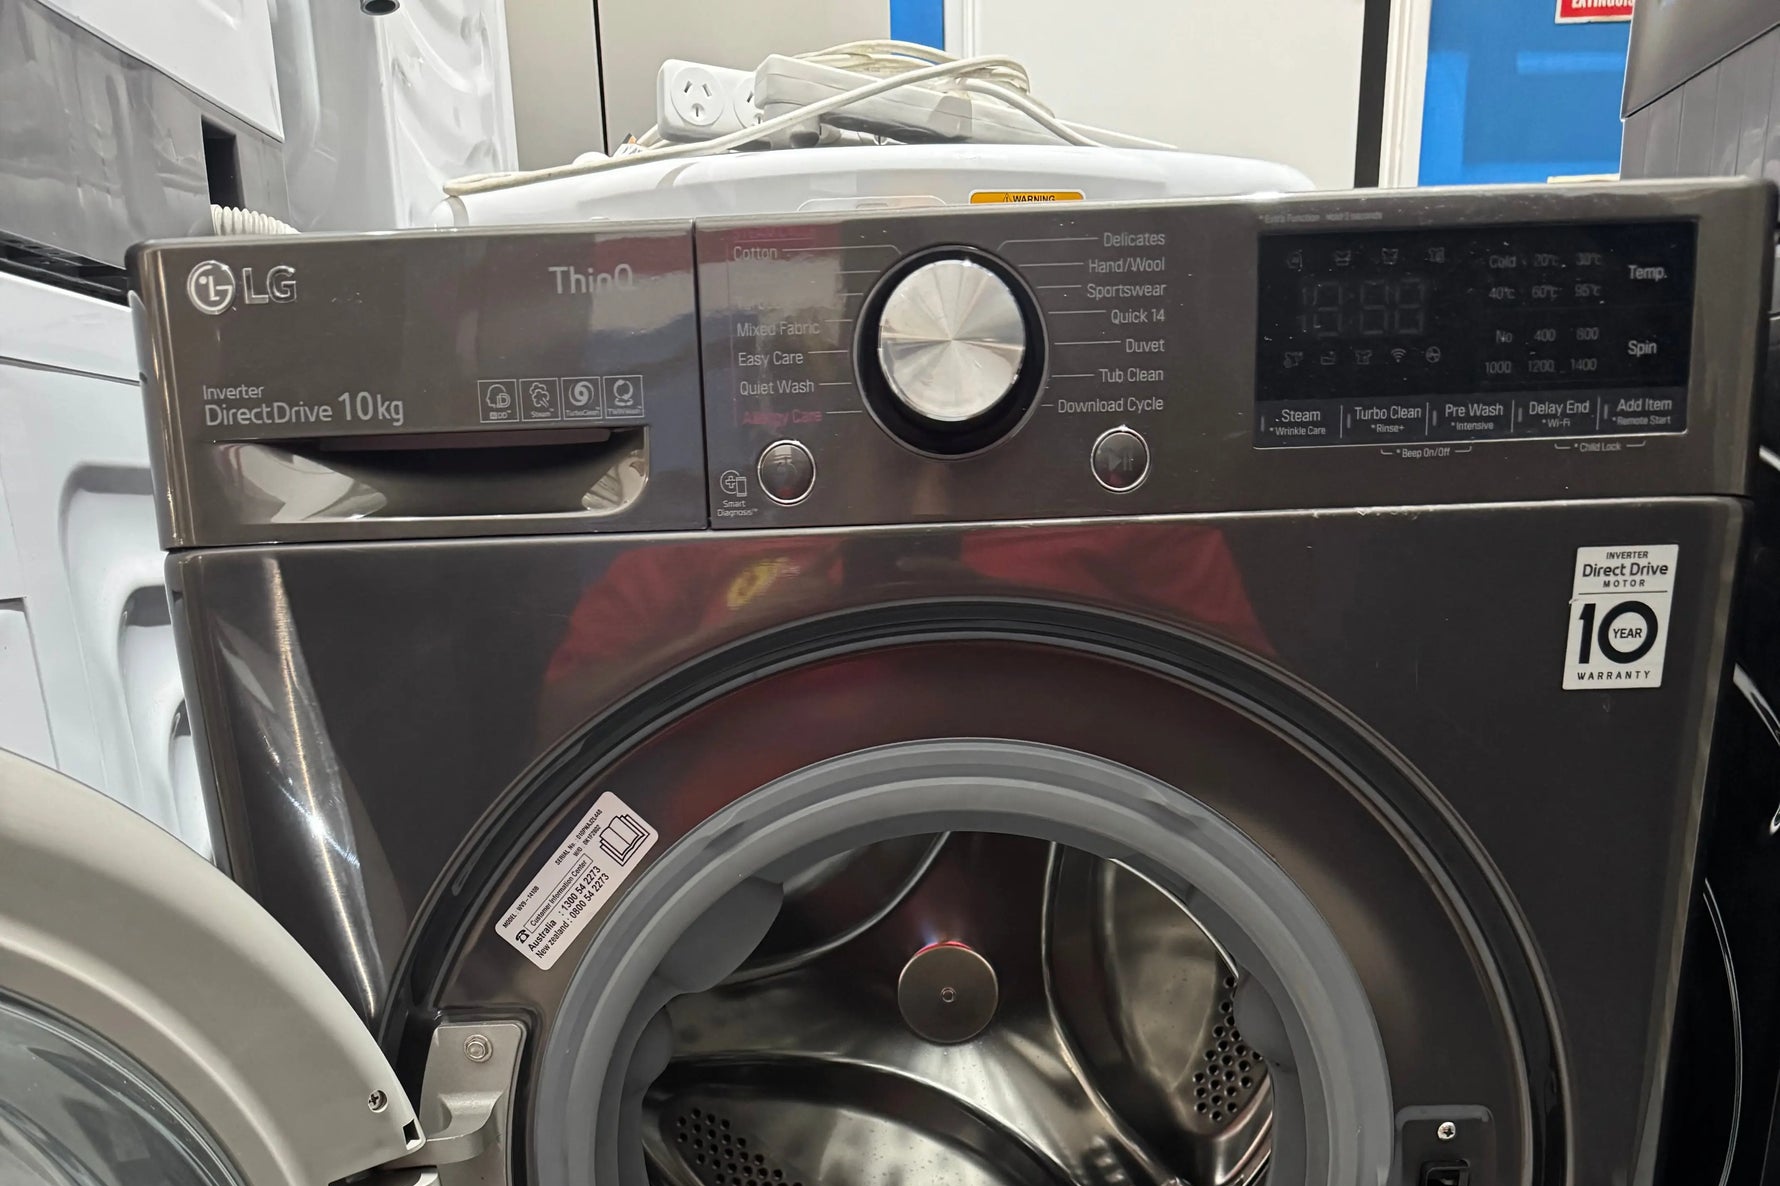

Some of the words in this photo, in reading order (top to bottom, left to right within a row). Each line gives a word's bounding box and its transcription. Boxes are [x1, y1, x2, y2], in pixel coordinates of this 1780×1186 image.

[1013, 195, 1056, 203] WARNING
[1103, 230, 1166, 248] Delicates
[734, 246, 778, 261] Cotton
[1088, 256, 1167, 274] Hand/Wool
[1488, 255, 1518, 269] Cold
[548, 262, 638, 297] ThinQ
[1628, 264, 1669, 281] Temp.
[243, 265, 298, 305] LG
[1087, 282, 1168, 299] Sportswear
[1111, 308, 1149, 325] Quick
[1151, 308, 1167, 323] 14
[737, 320, 776, 337] Mixed
[779, 318, 820, 335] Fabric
[1495, 329, 1514, 344] No
[1533, 328, 1557, 342] 400
[1125, 338, 1166, 354] Duvet
[1627, 340, 1658, 357] Spin
[738, 351, 772, 368] Easy
[774, 350, 804, 365] Care
[1484, 361, 1513, 375] 1000
[1527, 359, 1556, 373] 1200
[1570, 358, 1598, 372] 1400
[1099, 368, 1127, 383] Tub
[1128, 367, 1164, 382] Clean
[201, 382, 264, 401] Inverter
[739, 380, 774, 396] Quiet
[778, 378, 815, 394] Wash
[1057, 398, 1124, 414] Download
[1128, 396, 1165, 413] Cycle
[1354, 406, 1388, 421] Turbo
[1390, 405, 1423, 420] Clean
[1444, 403, 1471, 417] Pre
[1472, 402, 1504, 416] Wash
[1528, 401, 1563, 417] Delay
[1564, 400, 1591, 415] End
[1616, 398, 1641, 413] Add
[1643, 397, 1672, 412] Item
[1281, 407, 1322, 423] Steam
[1546, 417, 1571, 428] Wi-Fi
[1649, 414, 1672, 425] Start
[1274, 425, 1305, 437] Wrinkle
[1307, 425, 1327, 436] Care
[1455, 420, 1495, 431] Intensive
[1402, 448, 1423, 460] Beep
[1424, 446, 1450, 459] On/Off
[1579, 442, 1600, 453] Child
[1601, 441, 1622, 452] Lock
[722, 499, 747, 508] Smart
[1606, 551, 1649, 560] INVERTER
[1582, 563, 1627, 577] Direct
[1629, 562, 1669, 576] Drive
[1602, 579, 1646, 588] MOTOR
[1578, 600, 1659, 664] 10
[1612, 628, 1643, 639] YEAR
[1577, 670, 1651, 681] WARRANTY
[554, 848, 570, 865] SERIAL
[529, 901, 551, 926] Customer
[548, 875, 574, 904] Information
[570, 859, 587, 877] Center
[526, 917, 557, 951] Australia
[560, 891, 578, 912] 1300
[574, 882, 586, 894] 54
[582, 864, 601, 885] 2273
[535, 942, 550, 959] New
[546, 920, 569, 945] zealand
[568, 899, 587, 919] 0800
[583, 889, 595, 902] 54
[590, 871, 609, 892] 2273
[502, 912, 517, 928] MODEL
